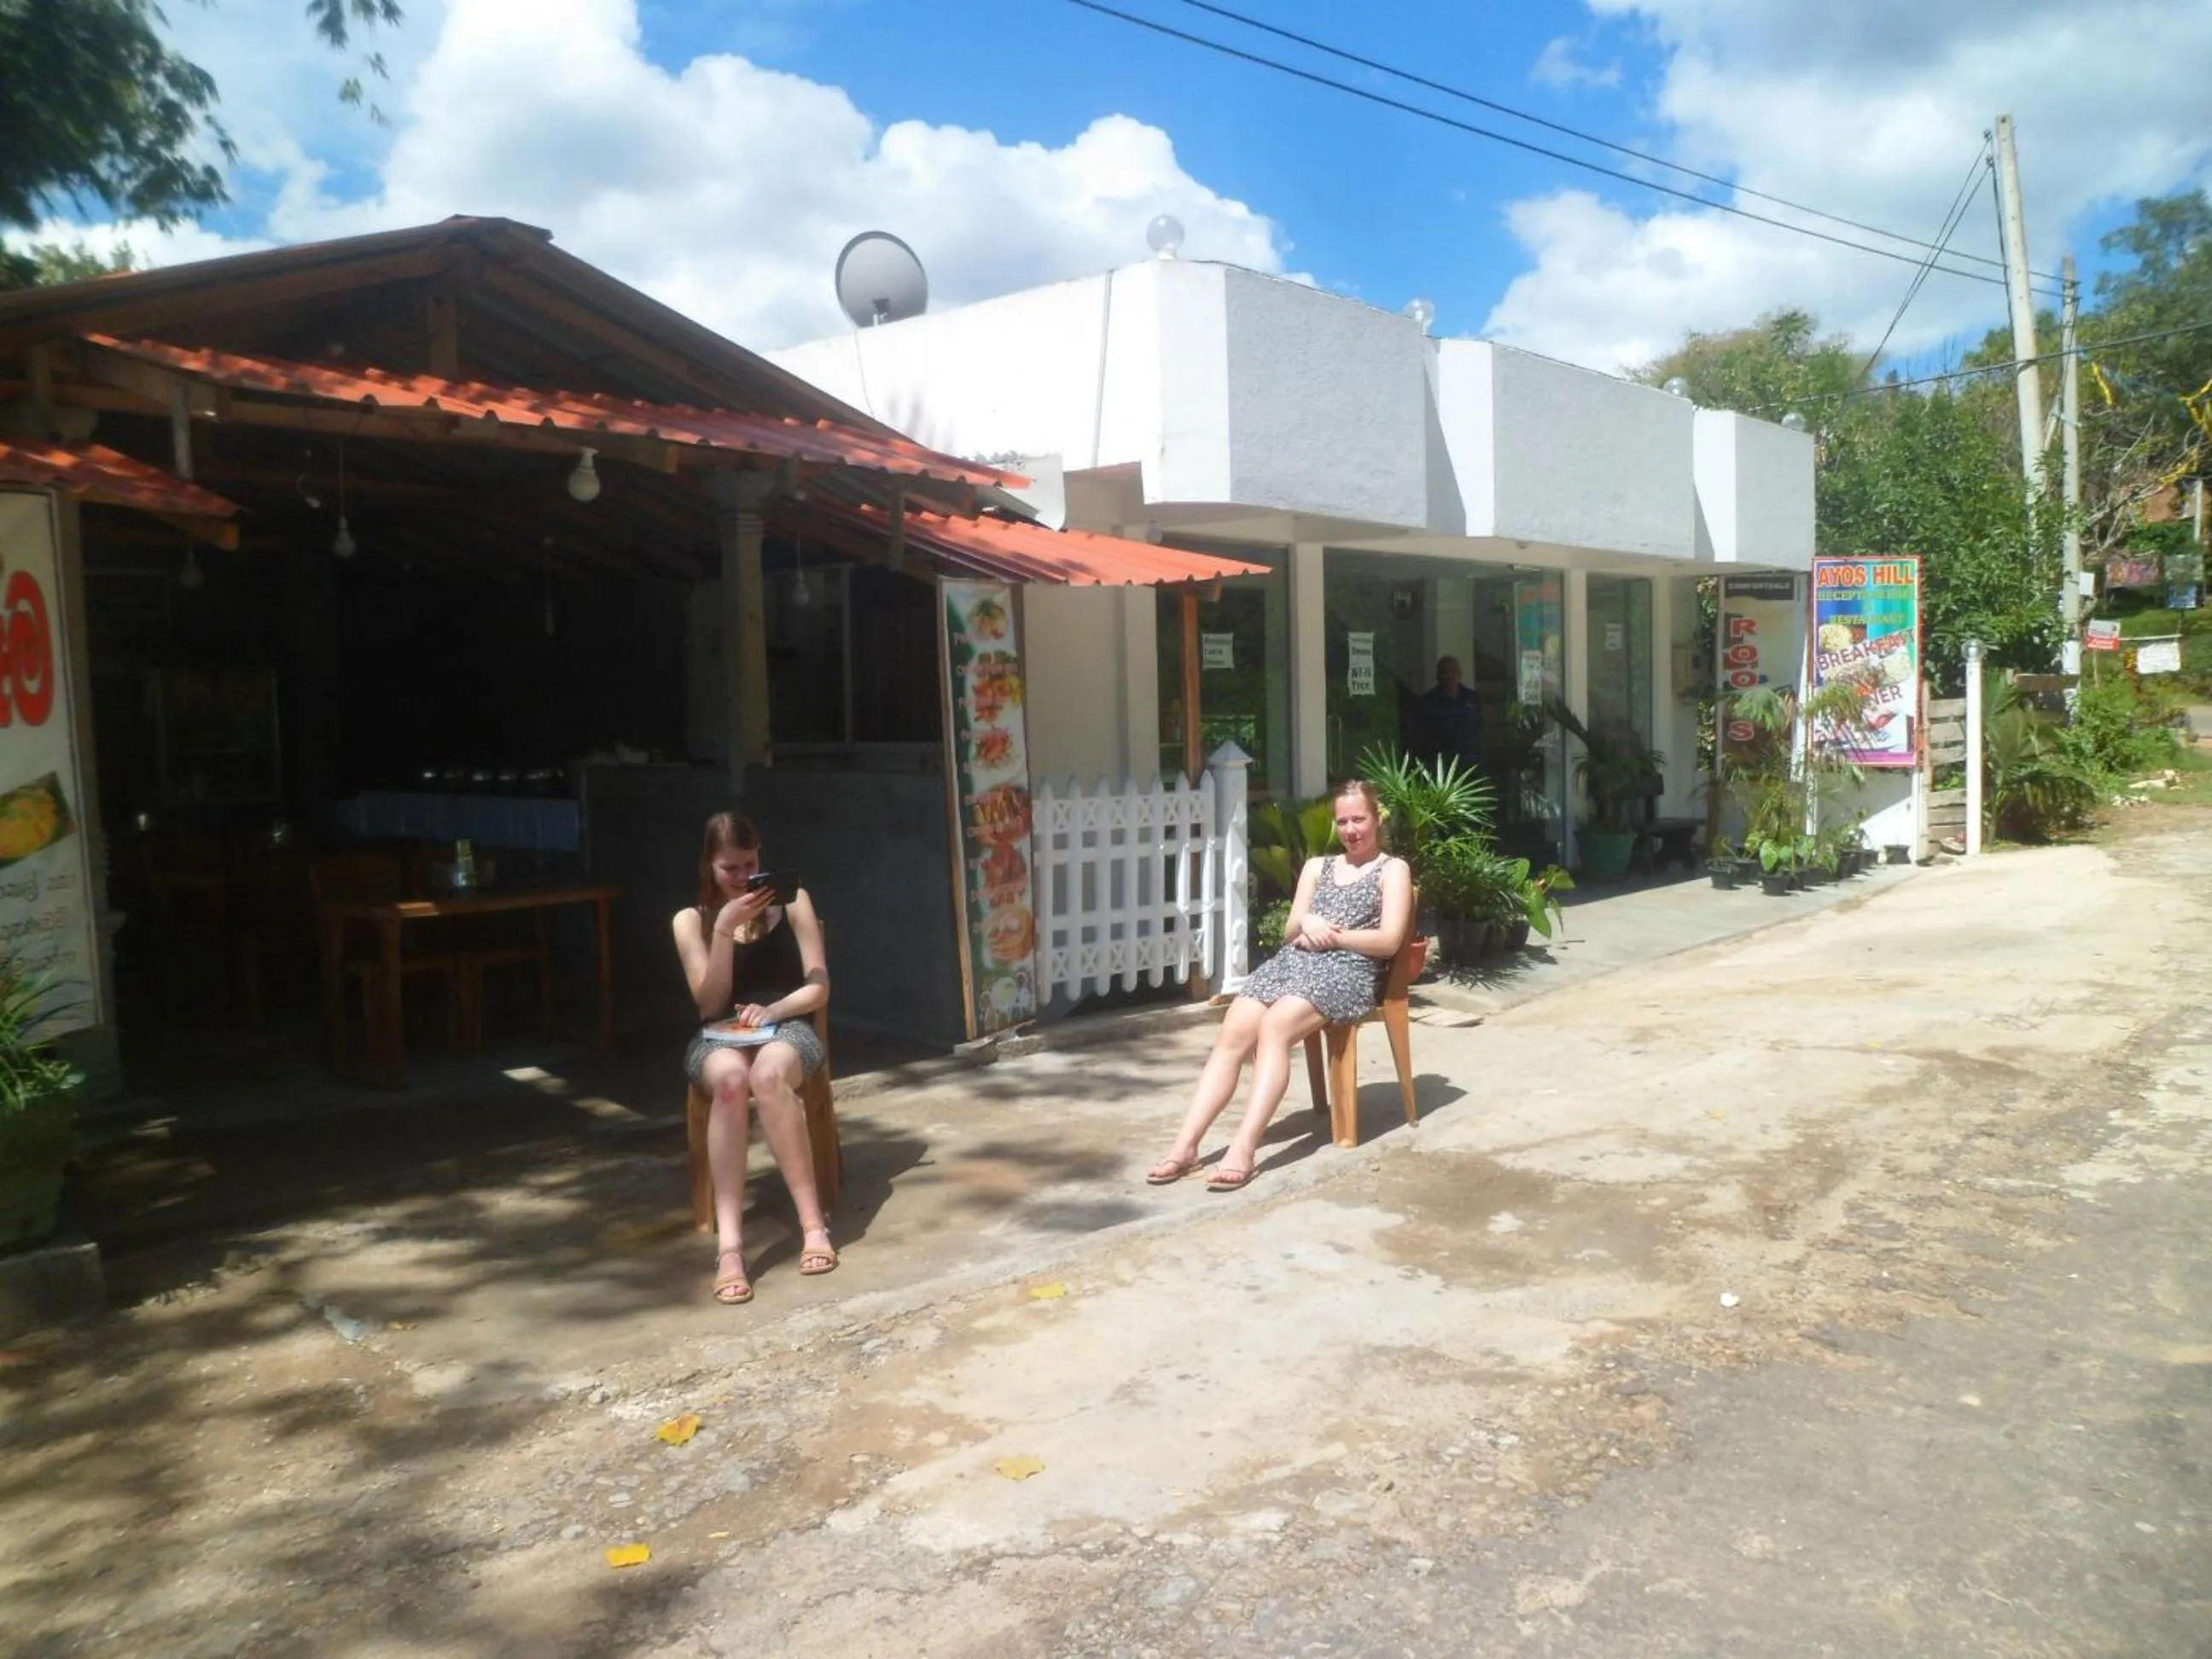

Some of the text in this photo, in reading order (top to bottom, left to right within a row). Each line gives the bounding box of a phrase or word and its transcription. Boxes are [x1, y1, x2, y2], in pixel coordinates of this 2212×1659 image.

[1818, 566, 1914, 586] AYOS HILL
[1728, 617, 1759, 741] ROOS
